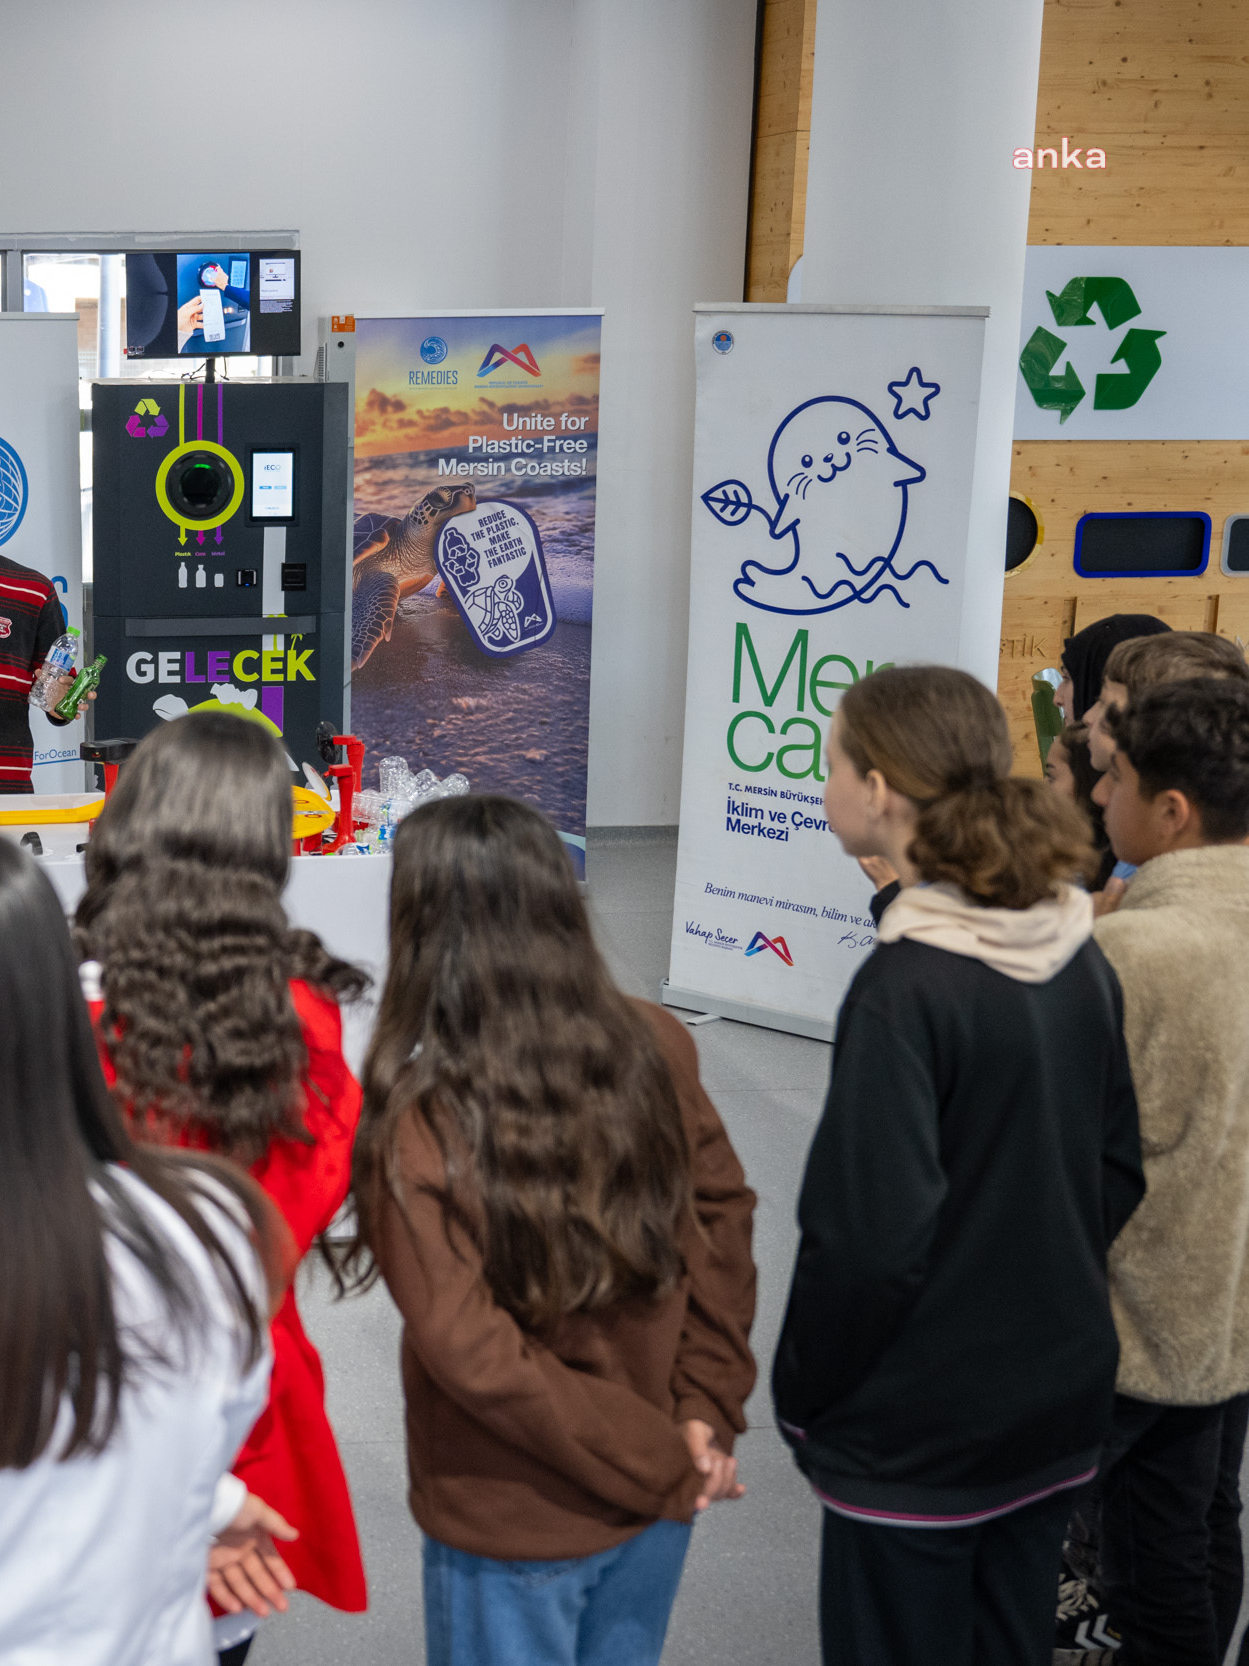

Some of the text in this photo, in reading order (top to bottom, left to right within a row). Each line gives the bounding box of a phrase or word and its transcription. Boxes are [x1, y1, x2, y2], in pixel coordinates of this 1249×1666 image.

[408, 370, 458, 386] REMEDIES
[503, 412, 589, 431] Unite for
[468, 435, 588, 454] Plastic-Free
[438, 457, 587, 476] Mersin Coasts!
[478, 510, 507, 528] REDUCE
[471, 529, 486, 542] THE
[488, 530, 511, 546] MAKE
[483, 537, 523, 559] THE EARTH
[487, 547, 527, 569] FANTASTIC
[125, 649, 316, 684] GELECEK
[34, 749, 77, 761] ForOcean
[728, 782, 742, 792] T.C.
[744, 785, 777, 798] MERSİN
[726, 796, 764, 820] İklim
[768, 810, 787, 824] ve
[726, 816, 789, 842] Merkezi
[704, 882, 736, 900] Benim
[737, 892, 775, 908] manevi
[774, 898, 818, 918] mirasım,
[821, 906, 848, 923] bilim
[850, 914, 862, 926] ve
[685, 921, 713, 944] Vahap
